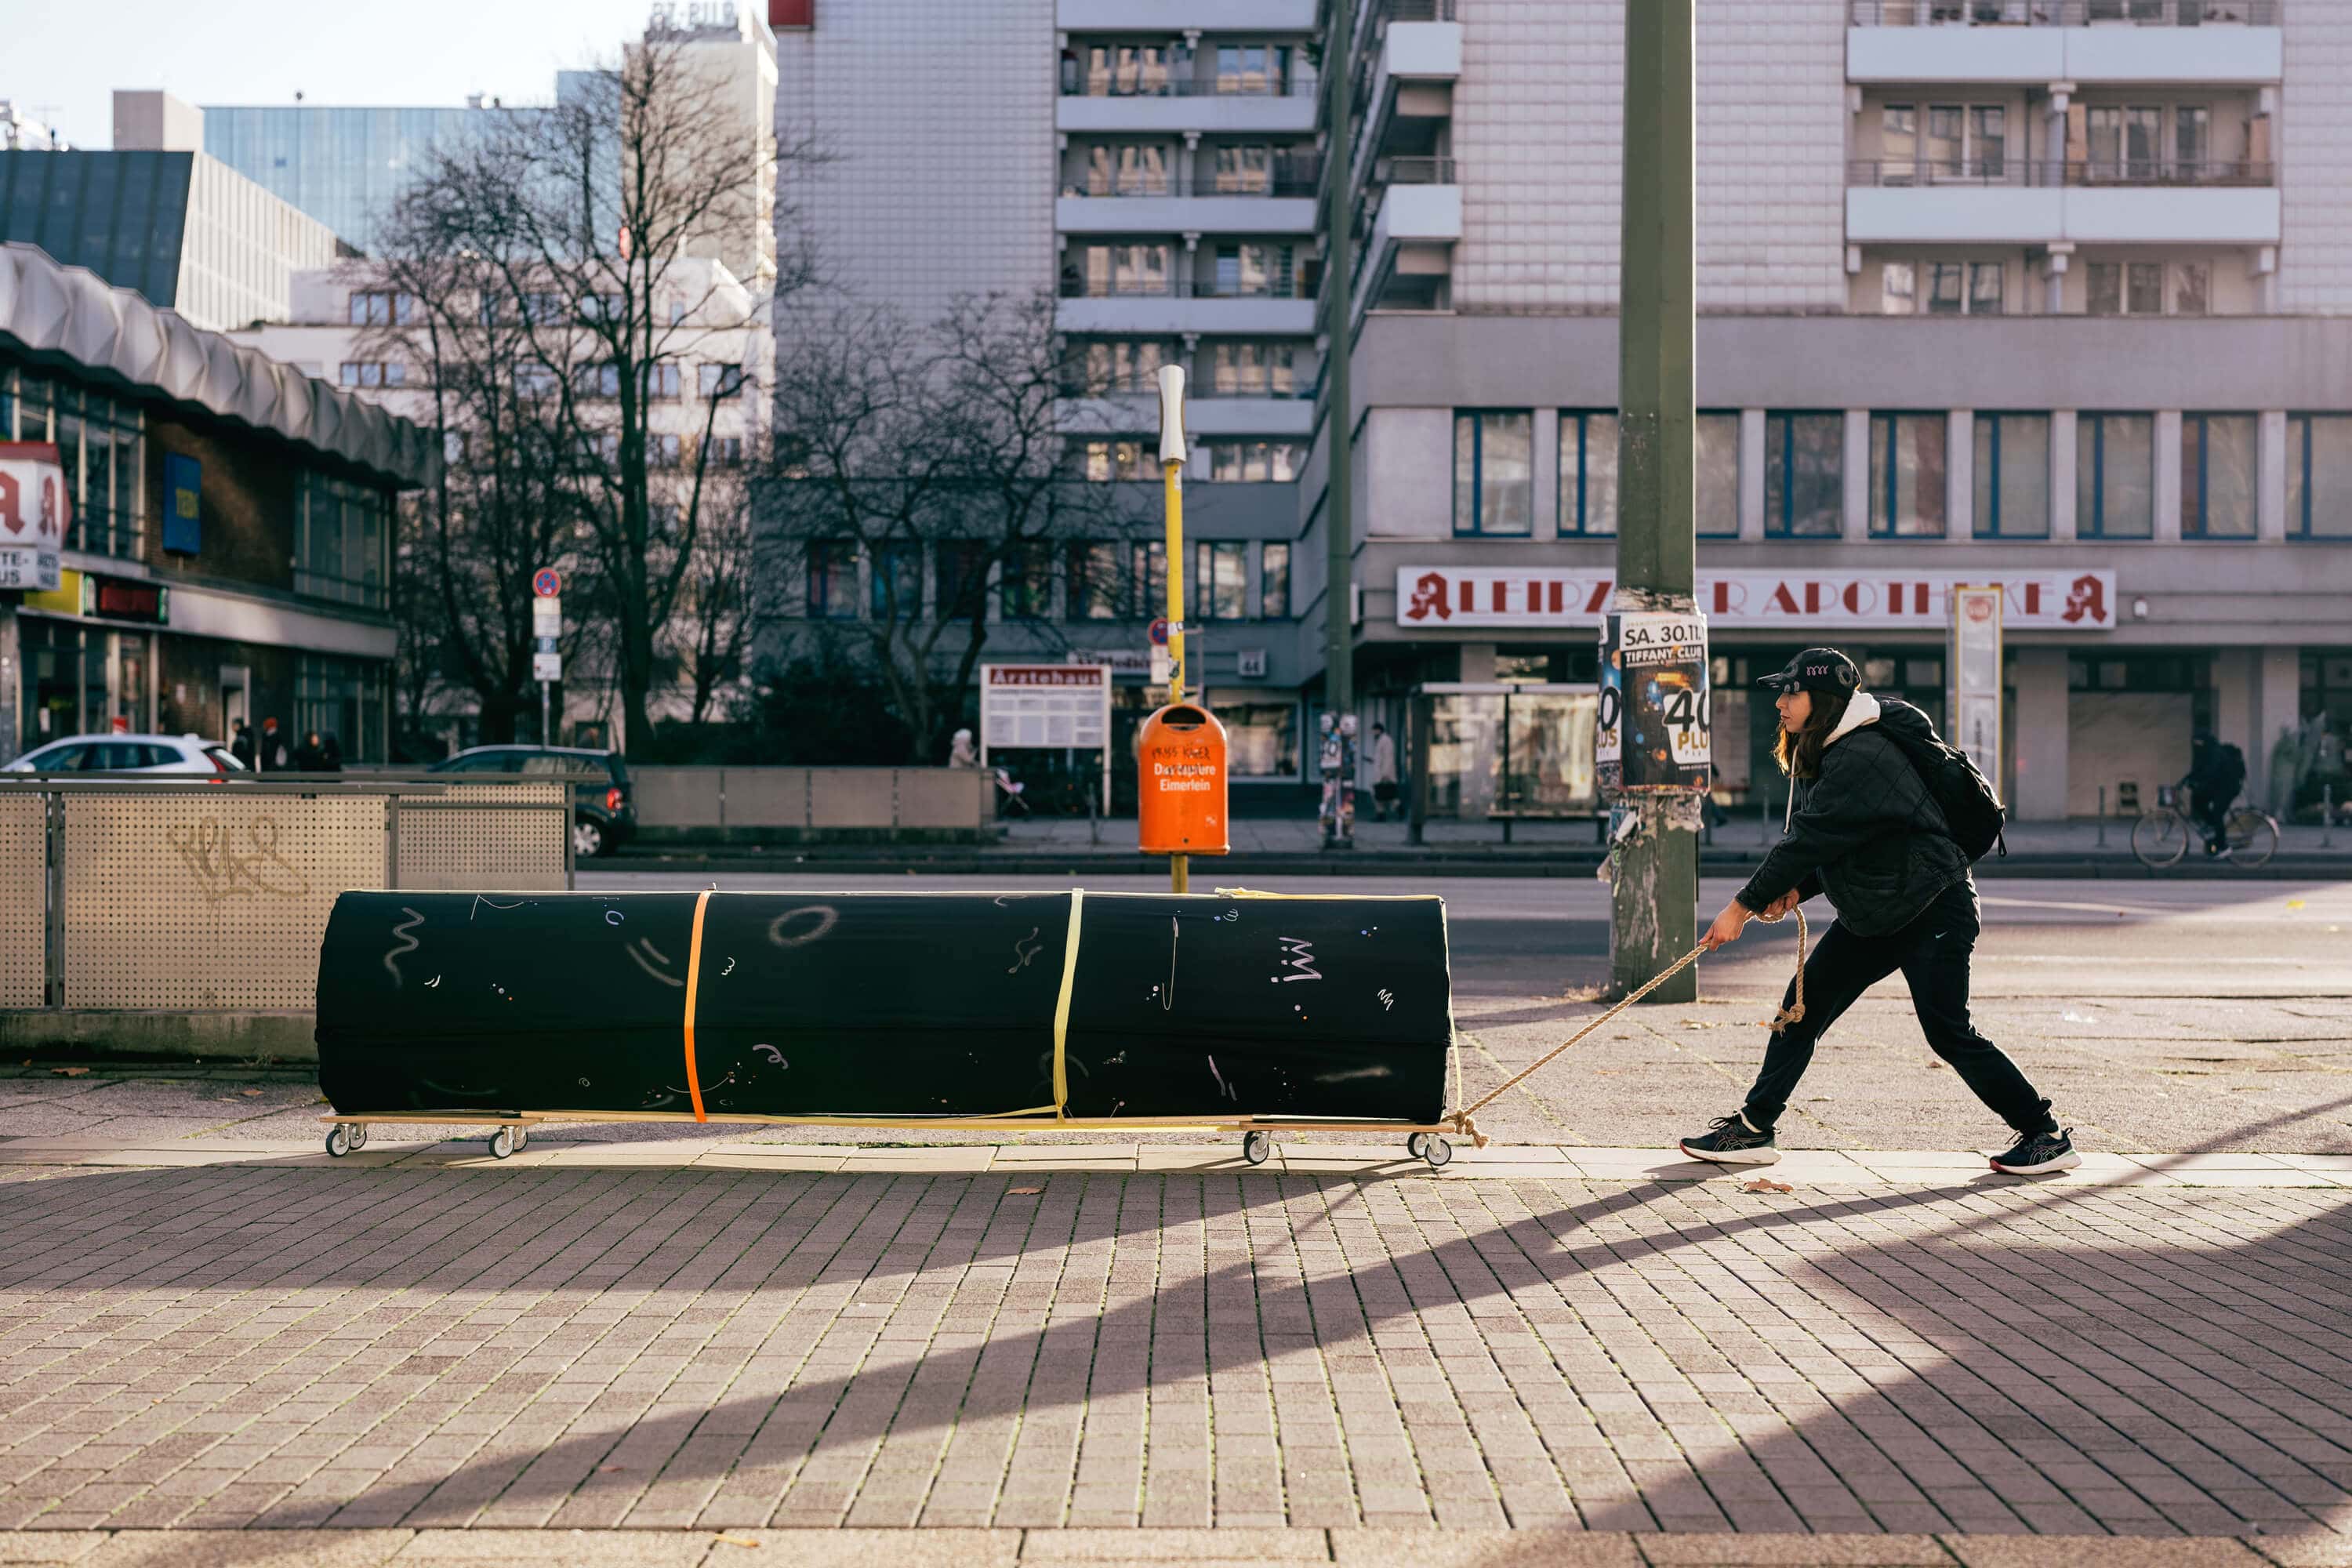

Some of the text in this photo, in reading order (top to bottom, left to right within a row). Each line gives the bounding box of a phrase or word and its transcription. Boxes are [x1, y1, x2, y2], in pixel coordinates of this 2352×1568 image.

[1625, 626, 1654, 646] SA.
[1661, 624, 1701, 642] 30.11.
[1625, 648, 1674, 662] TIFFANY
[1677, 644, 1703, 659] CLUB
[993, 669, 1102, 684] Ärztehaus
[1598, 686, 1621, 731] 0
[1160, 779, 1210, 791] Eimerlein
